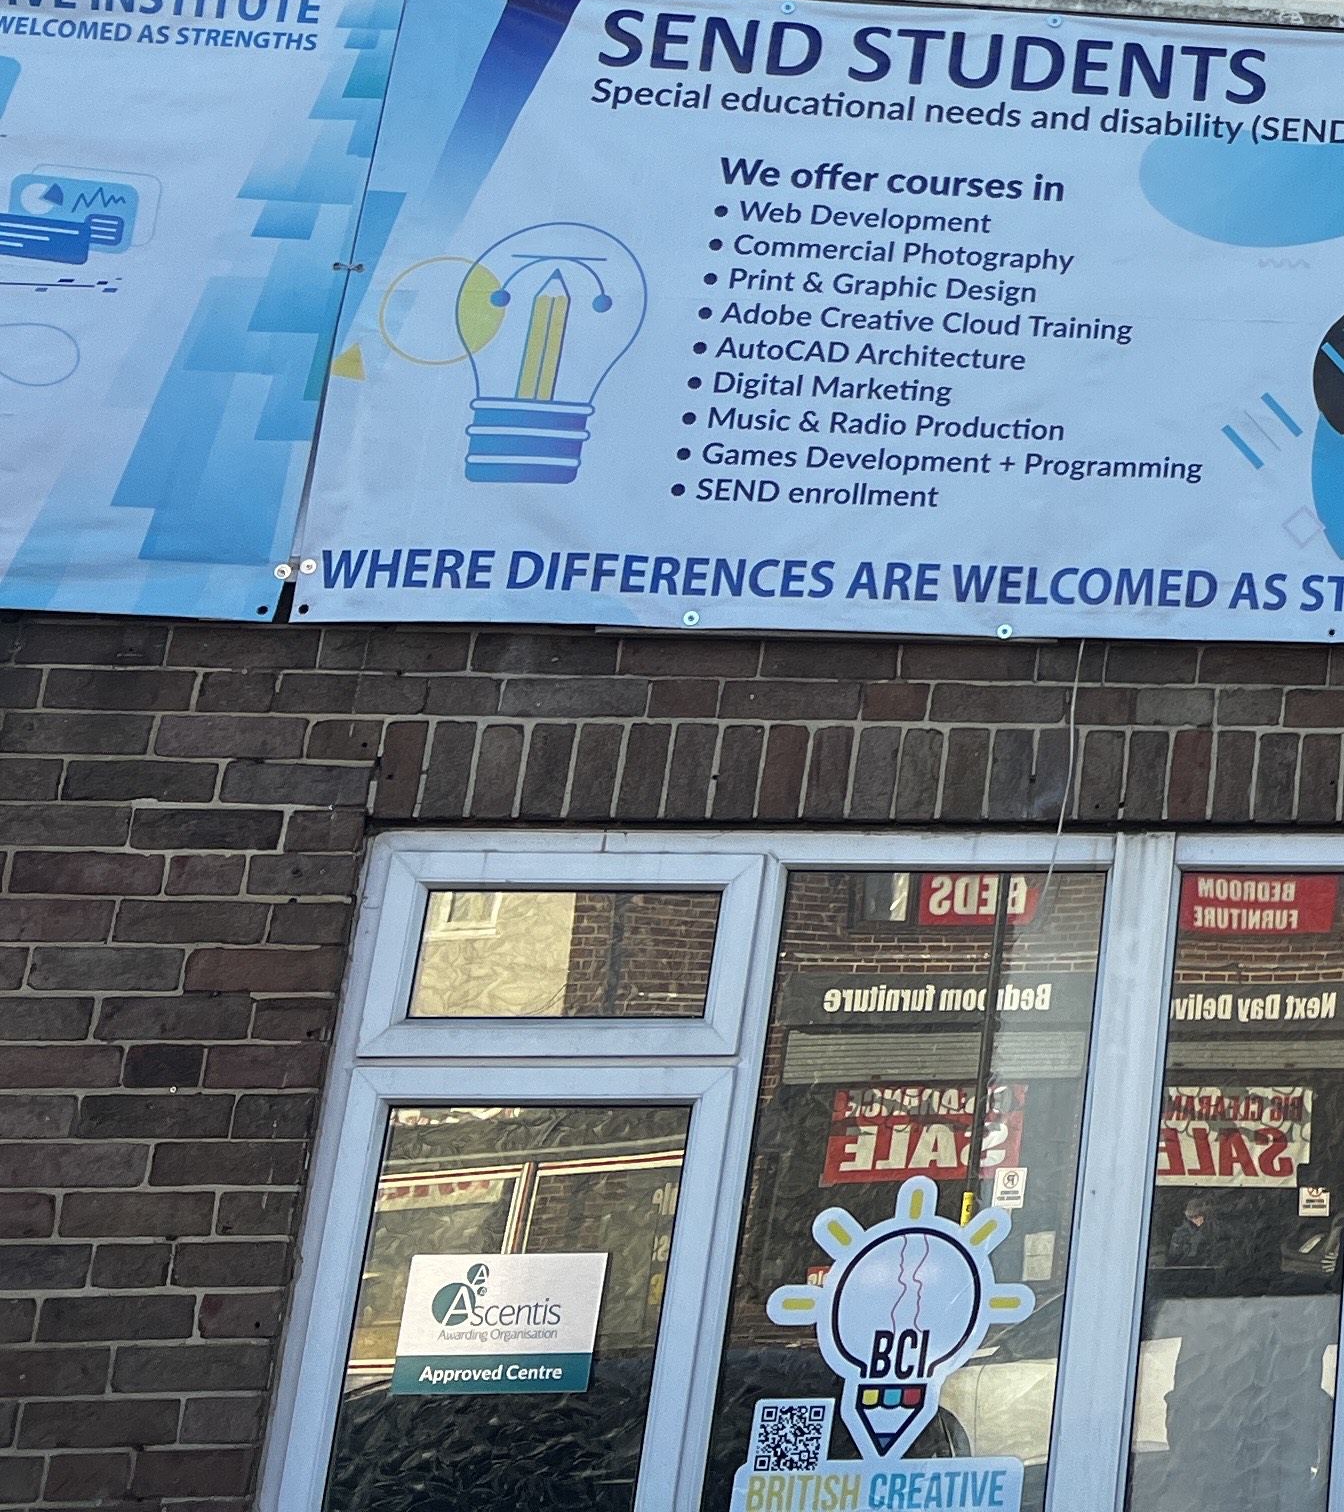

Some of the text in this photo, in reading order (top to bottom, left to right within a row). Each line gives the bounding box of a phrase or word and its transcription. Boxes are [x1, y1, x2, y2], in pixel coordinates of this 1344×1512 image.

[0, 15, 318, 51] WELCOMED AS STRENGTHS
[598, 9, 1267, 105] SEND STUDENTS
[591, 77, 712, 110] Special
[721, 86, 915, 121] educational
[925, 100, 1021, 128] needs
[1030, 106, 1091, 131] and
[1100, 108, 1243, 145] disability
[720, 157, 1065, 202] We offer courses in
[740, 201, 991, 234] Web Development
[734, 234, 1075, 275] Commercial Photography
[728, 268, 1037, 306] Print & Graphic Design
[720, 302, 1133, 345] Adobe Creative Cloud Training
[715, 336, 1026, 371] AutoCAD Architecture
[713, 371, 952, 407] Digital Marketing
[707, 406, 1064, 442] Music & Radio Production
[702, 442, 1203, 484] Games Development + Programming
[695, 478, 939, 508] SEND enrollment
[321, 549, 495, 590] WHERE
[506, 550, 835, 600] DIFFERENCES
[845, 561, 943, 602] ARE
[952, 564, 1218, 610] WELCOMED
[1228, 572, 1288, 612] AS
[440, 1285, 562, 1327] Ascentis
[437, 1328, 558, 1343] Awarding Organisation
[869, 1329, 930, 1380] BCI
[418, 1364, 563, 1384] Approved Centre
[745, 1470, 1008, 1512] BRITISH CREATIVE
